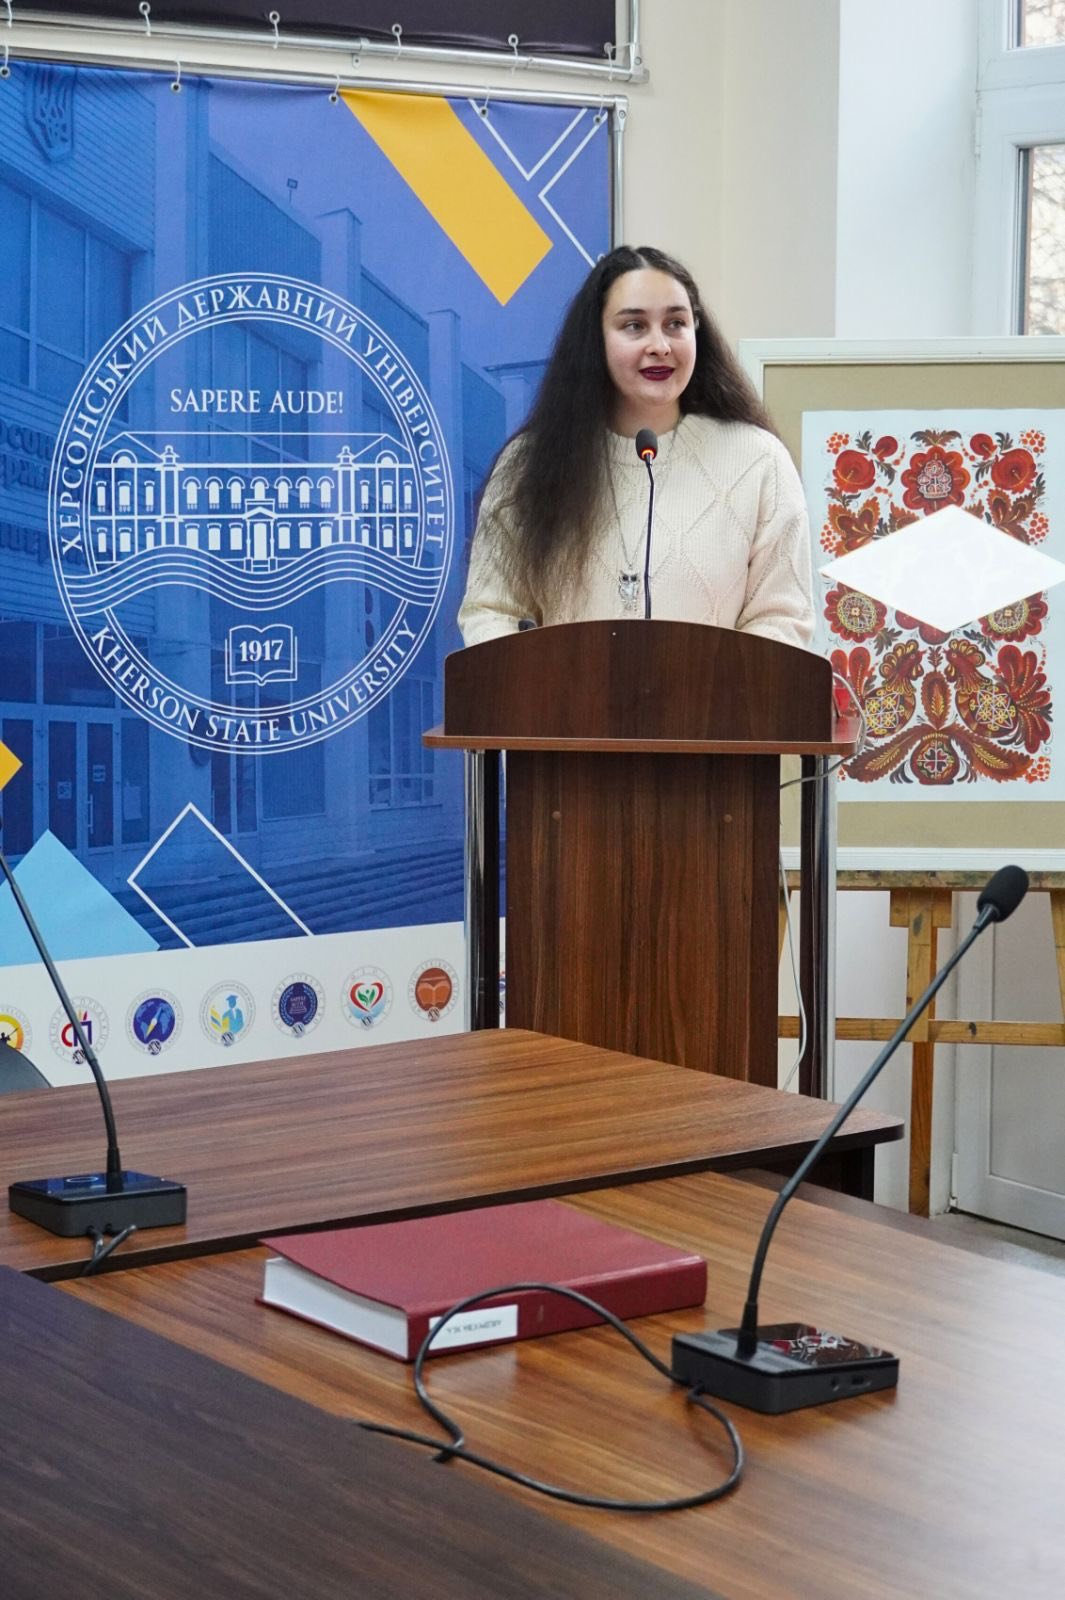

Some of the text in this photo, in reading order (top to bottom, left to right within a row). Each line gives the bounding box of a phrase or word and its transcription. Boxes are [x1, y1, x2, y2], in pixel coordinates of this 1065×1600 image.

[60, 285, 446, 554] ХЕРСОНСЬКИЙ ДЕРЖАВНИЙ УНІВЕРСИТЕТ
[170, 389, 343, 414] SAPERE AUDE!
[91, 619, 417, 742] KHERSON STATE UNIVERSITY
[239, 640, 284, 661] 1917
